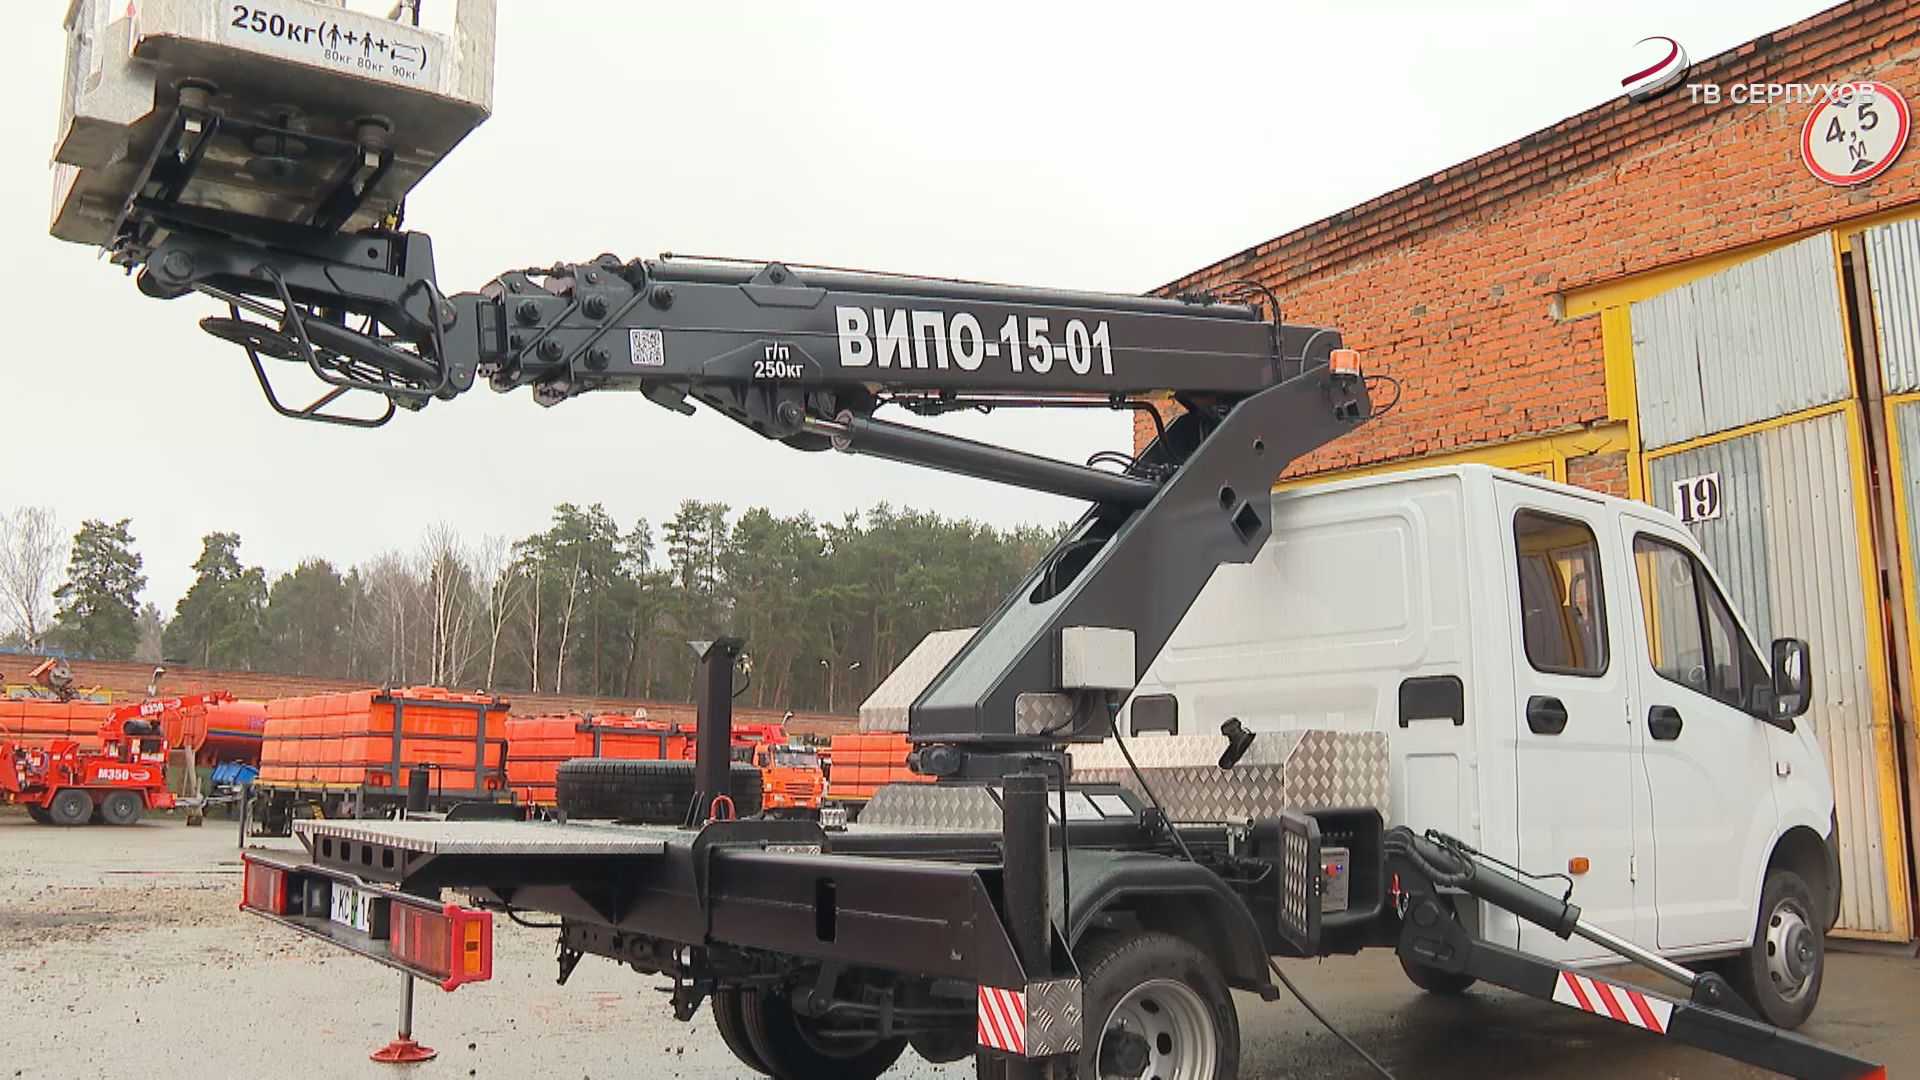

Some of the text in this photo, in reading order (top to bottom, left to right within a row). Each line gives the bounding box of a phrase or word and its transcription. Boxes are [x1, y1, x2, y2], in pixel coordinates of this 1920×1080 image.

[324, 49, 417, 80] 80кг 80кг 90кг
[1825, 103, 1878, 144] 4,5
[835, 305, 1114, 375] ВИПО-15-01
[753, 361, 804, 378] 250кг
[1678, 478, 1717, 521] 19
